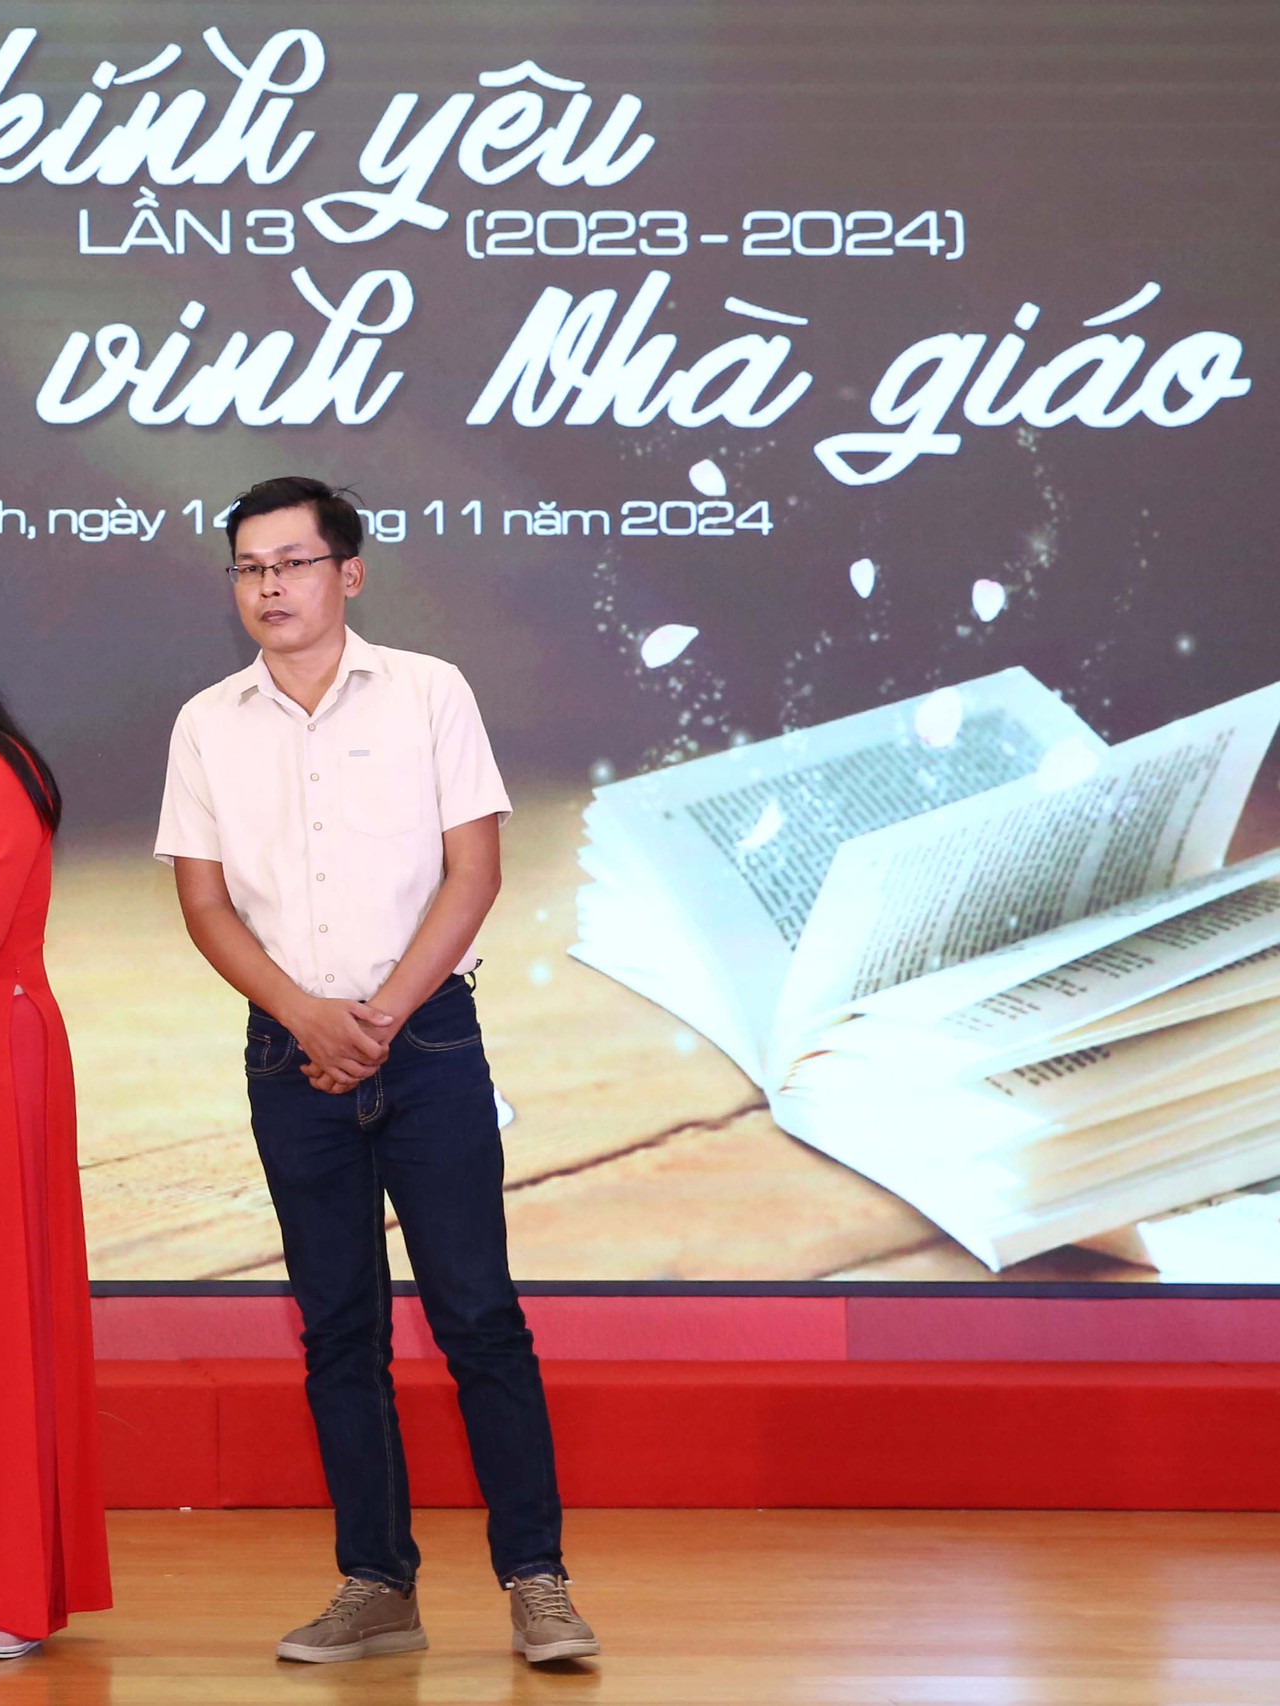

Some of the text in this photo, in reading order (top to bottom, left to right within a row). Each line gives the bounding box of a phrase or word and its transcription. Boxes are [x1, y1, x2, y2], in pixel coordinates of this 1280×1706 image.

[302, 59, 657, 244] yêu
[78, 186, 232, 256] LẦN
[246, 210, 297, 256] 3
[466, 209, 689, 261] (2023
[743, 209, 965, 261] 2024)
[36, 267, 415, 427] vinh
[466, 270, 814, 428] Nhà
[813, 281, 1253, 487] giáo
[48, 497, 168, 544] ngày
[503, 500, 611, 537] năm
[620, 500, 776, 537] 2024
